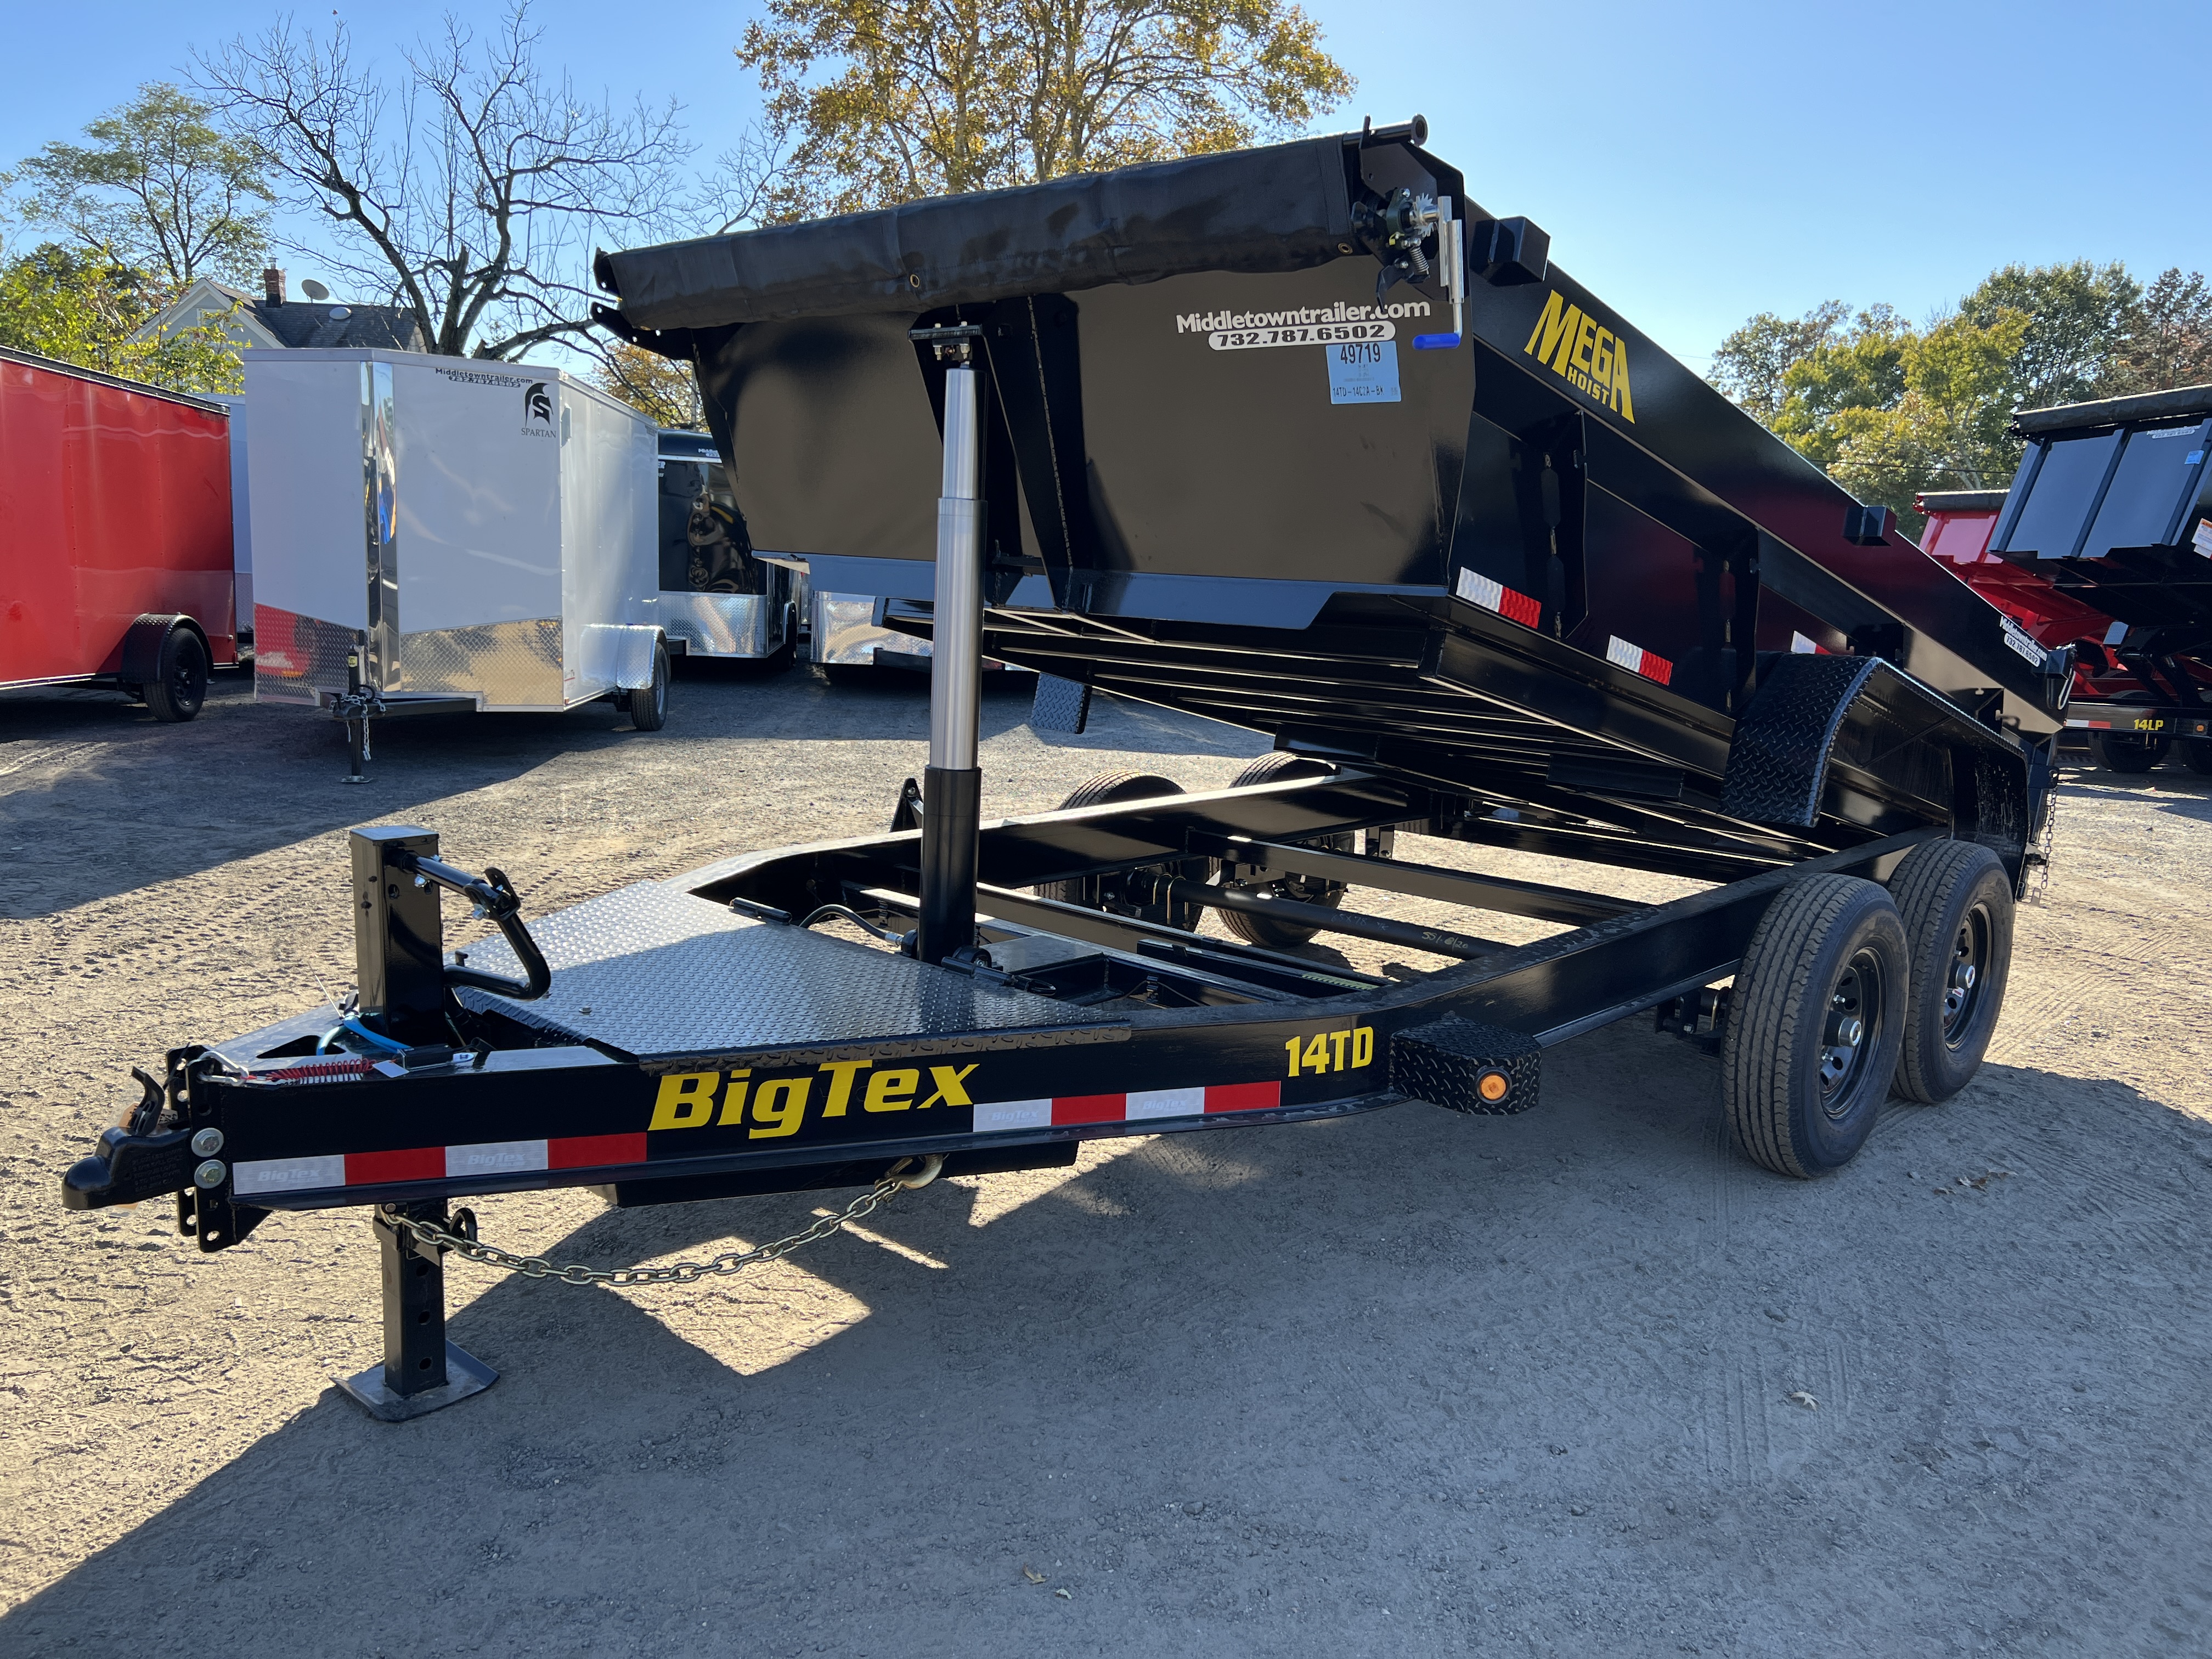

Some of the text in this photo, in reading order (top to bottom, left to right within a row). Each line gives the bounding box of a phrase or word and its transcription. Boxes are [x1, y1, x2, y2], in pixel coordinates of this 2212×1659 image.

[1176, 301, 1431, 334] Middletowntrailer.com
[1217, 324, 1385, 347] 732.787.6502
[1340, 343, 1381, 364] 49719
[1524, 289, 1635, 424] MEGA
[435, 368, 533, 384] Middletowntrailer.com
[1567, 366, 1610, 405] HOIST
[521, 427, 556, 438] SPARTAN
[2006, 635, 2038, 665] 732.787.6502
[2134, 719, 2164, 731] 14LP
[1285, 1026, 1374, 1077] 14TD
